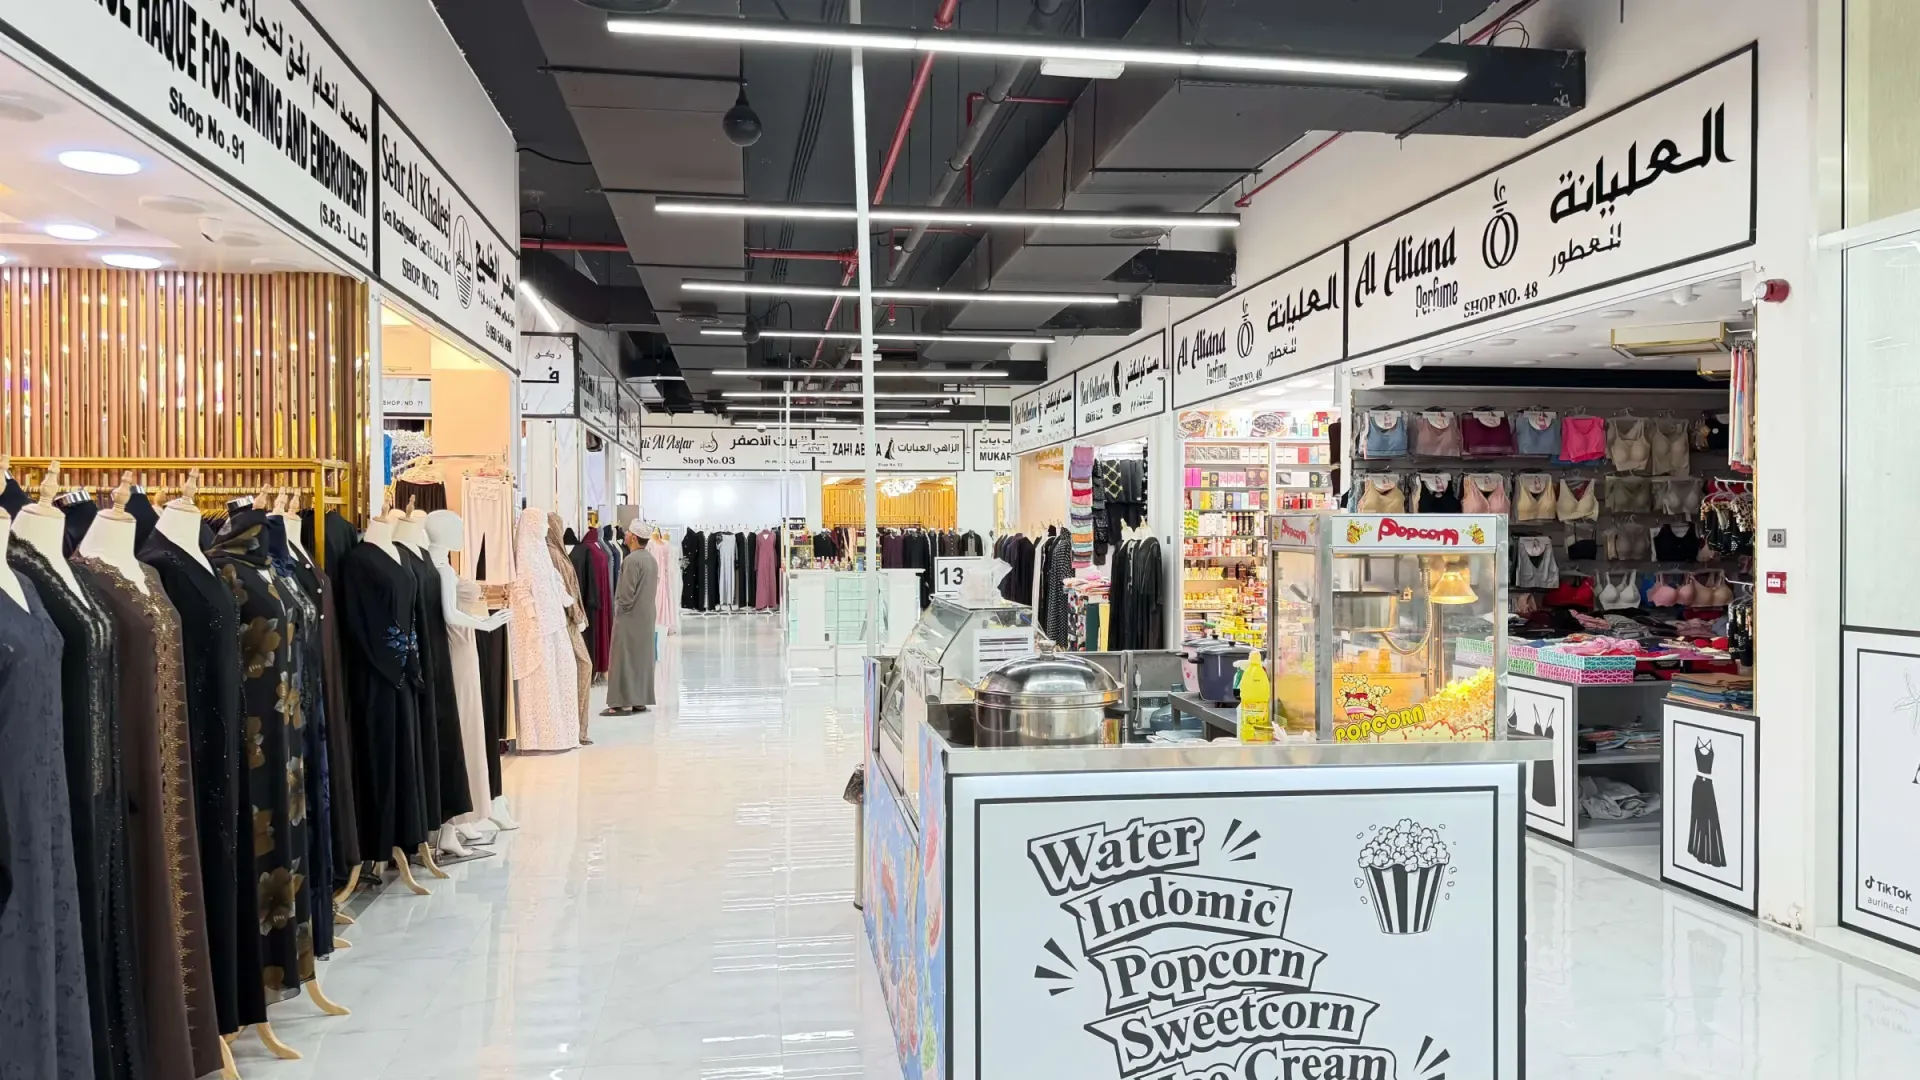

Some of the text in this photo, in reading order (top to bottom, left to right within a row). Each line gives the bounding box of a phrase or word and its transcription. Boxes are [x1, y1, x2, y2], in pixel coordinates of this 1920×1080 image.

[169, 86, 204, 138] Shop
[202, 17, 231, 109] FOR
[234, 51, 283, 150] SEWING
[286, 98, 308, 170] AND
[310, 119, 368, 219] EMBROIDERY
[1549, 101, 1736, 225] العليانة
[381, 133, 451, 252] Sehr Al Khaleej
[402, 258, 420, 287] SHOP
[1354, 225, 1458, 309] Al Aliana
[1267, 271, 1341, 333] العليانة
[1415, 275, 1459, 318] Perfume
[1464, 293, 1496, 319] SHOP
[1524, 281, 1539, 300] 48
[1177, 326, 1226, 375] Al Aliana
[682, 456, 705, 467] Shop
[832, 443, 853, 456] ZAHI
[1377, 517, 1460, 546] Popcorn
[1771, 533, 1783, 544] 48
[939, 566, 965, 586] 13
[1037, 821, 1197, 888] Water
[1085, 876, 1277, 940] Indomic
[1867, 896, 1909, 916] aurine.caf
[1876, 880, 1913, 902] TikTok
[1110, 945, 1306, 999] Popcorn
[1121, 989, 1357, 1060] Sweetcorn
[1245, 1047, 1387, 1080] Cream
